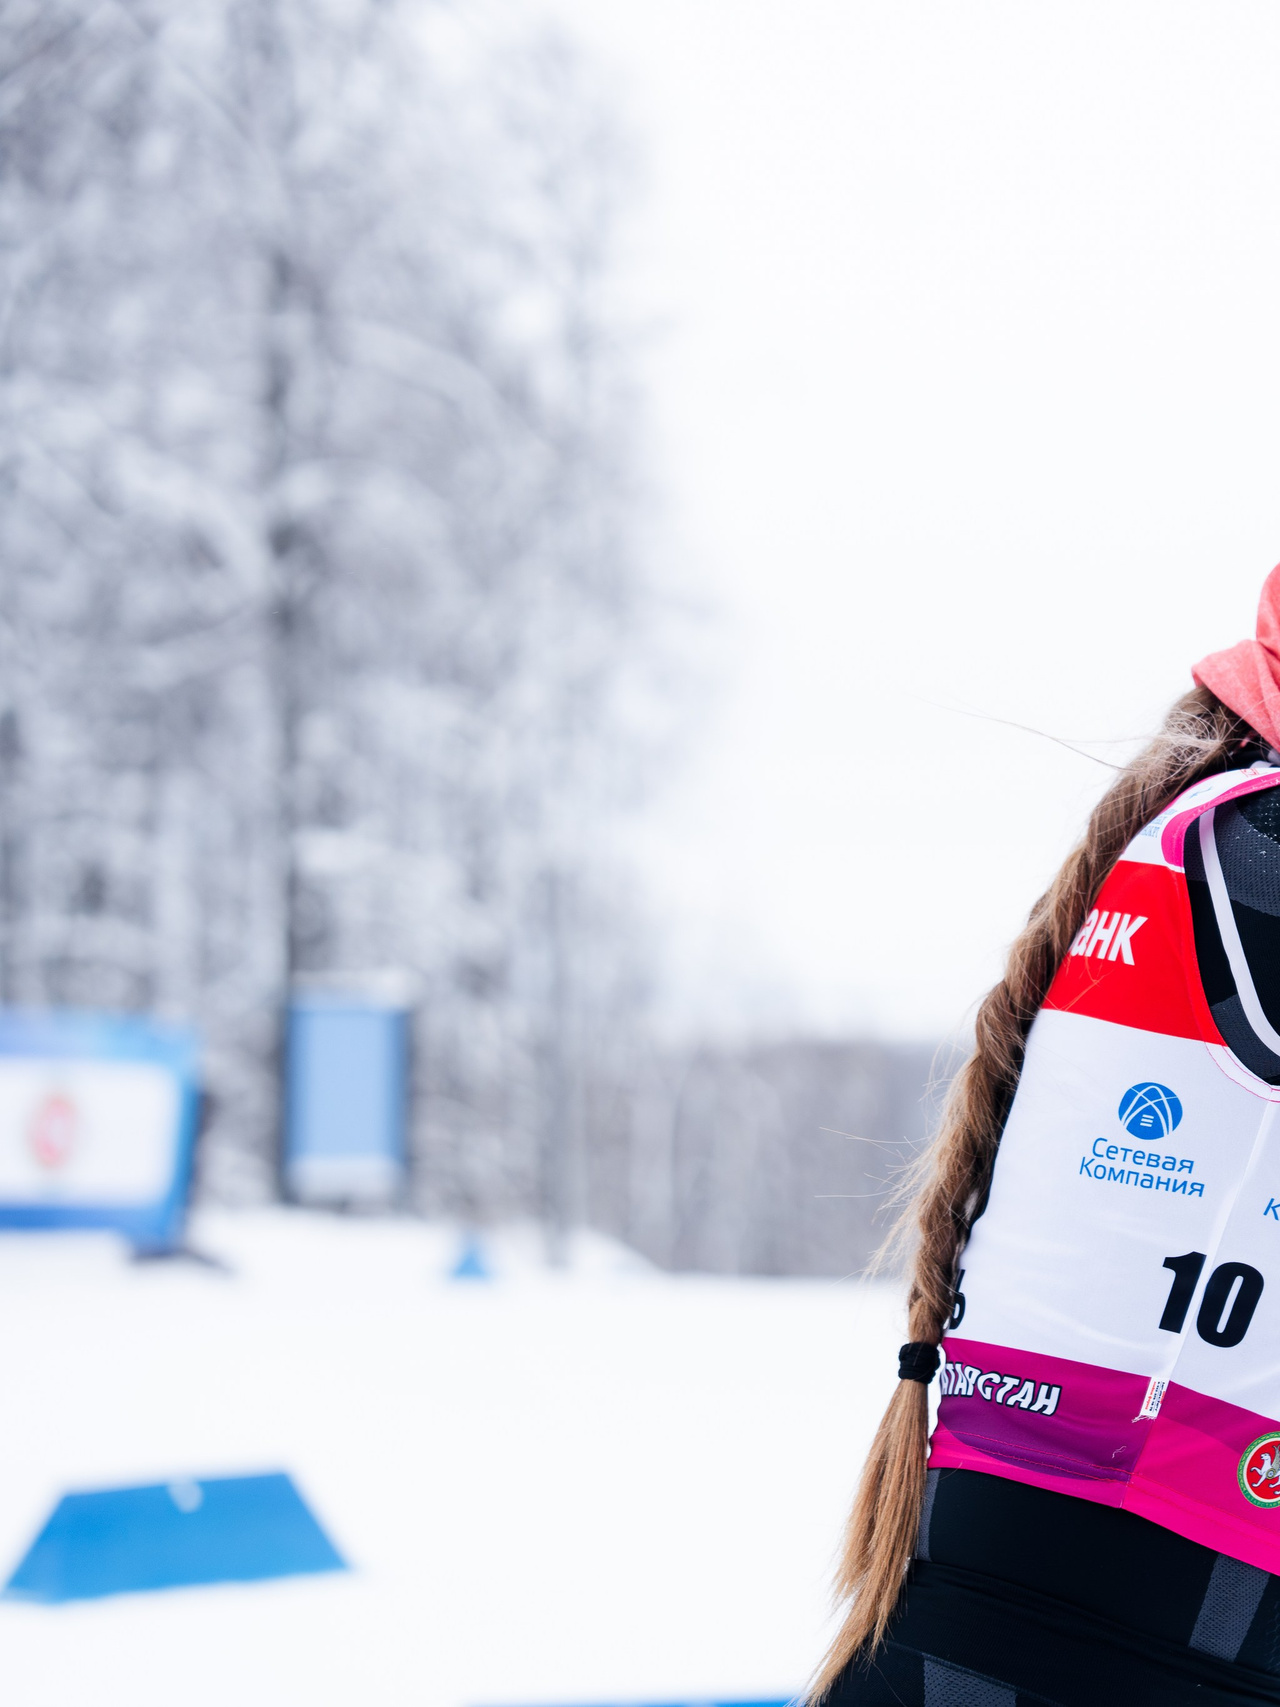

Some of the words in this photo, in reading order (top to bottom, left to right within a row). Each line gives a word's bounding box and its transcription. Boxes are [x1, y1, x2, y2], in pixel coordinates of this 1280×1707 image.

[1079, 1156, 1205, 1198] Компания
[1091, 1137, 1195, 1175] Сетевая
[1158, 1251, 1265, 1349] 10
